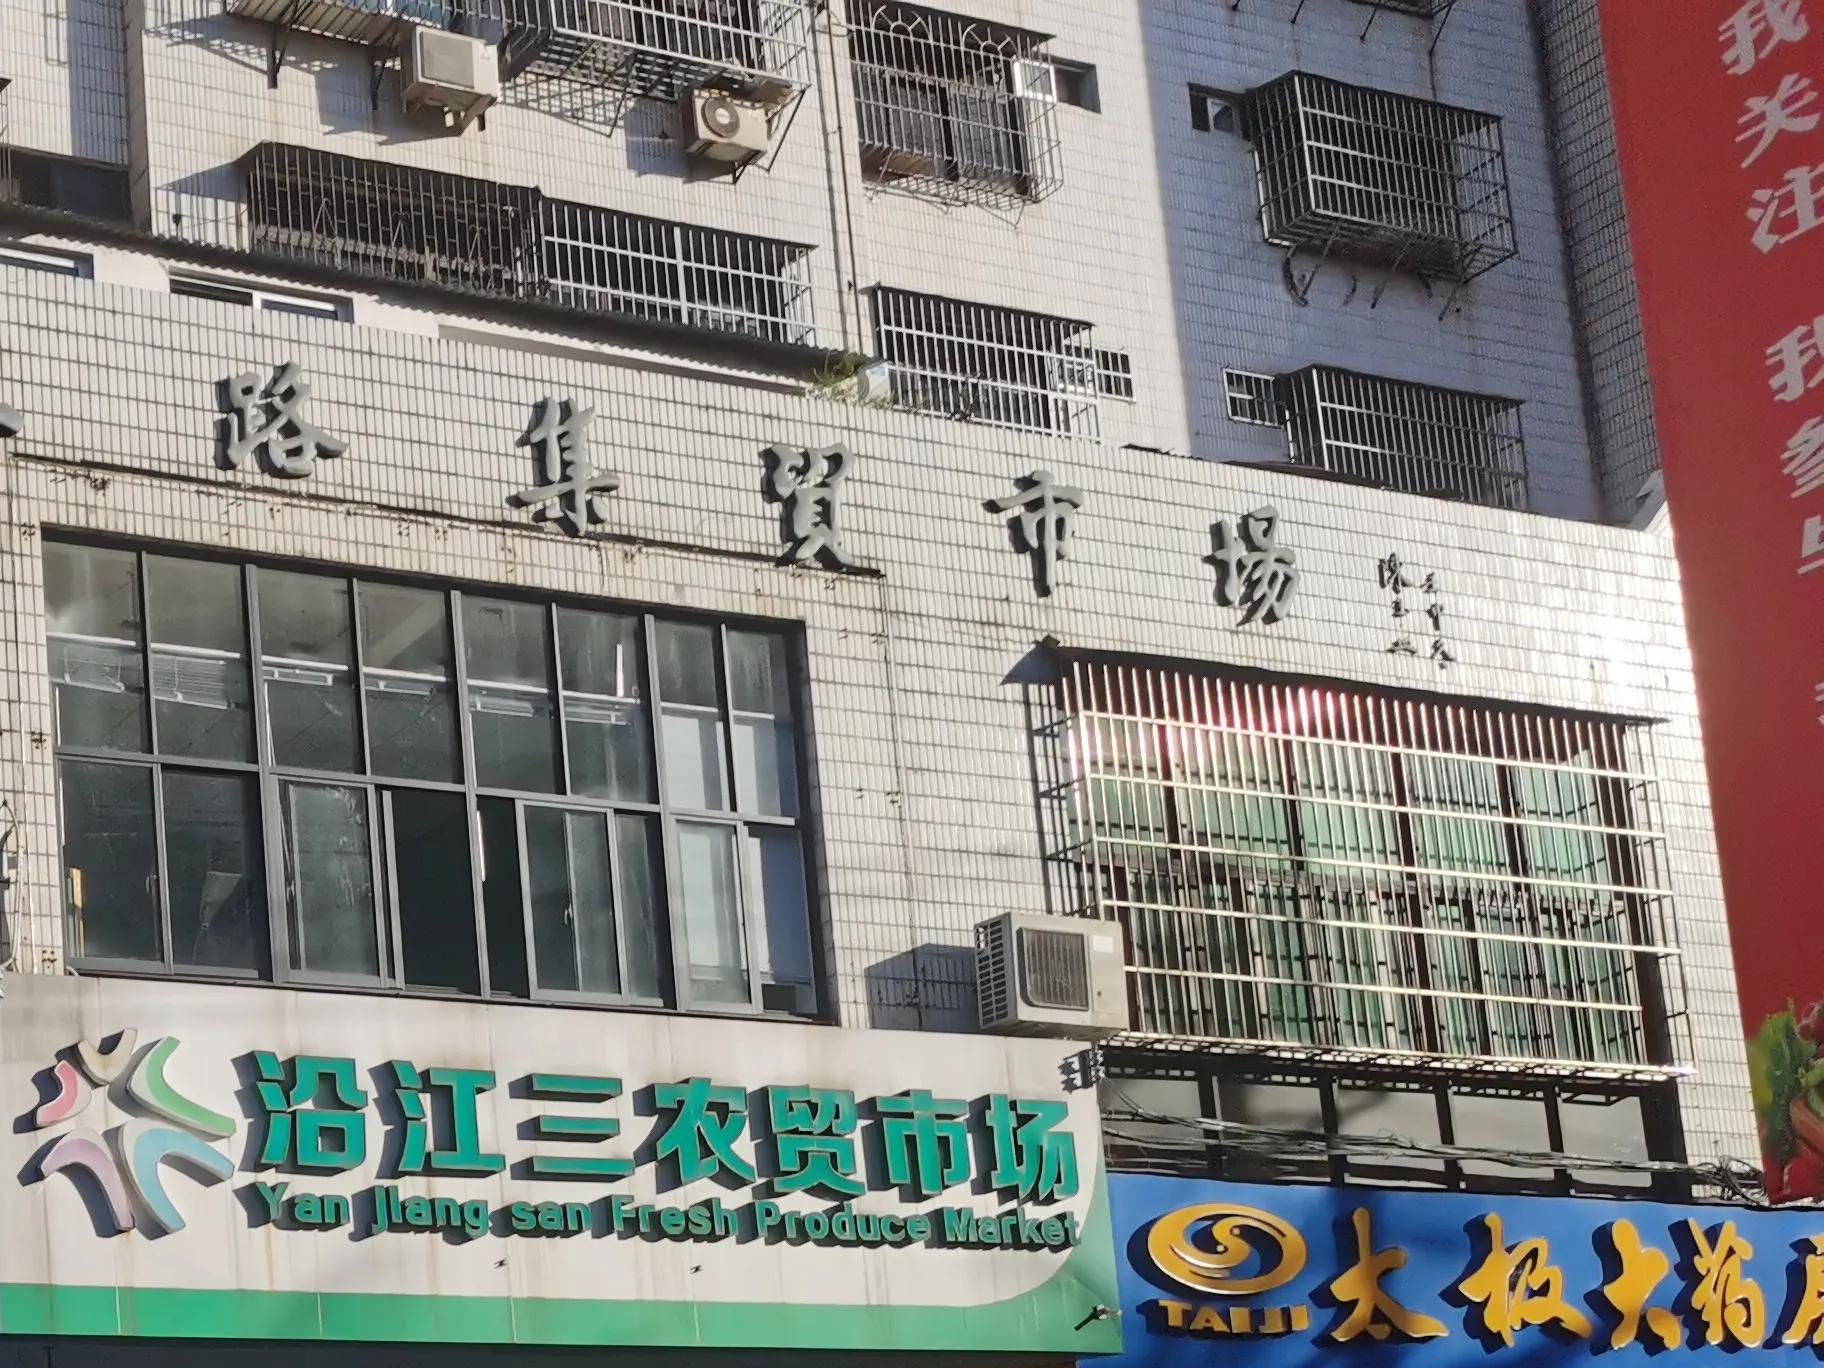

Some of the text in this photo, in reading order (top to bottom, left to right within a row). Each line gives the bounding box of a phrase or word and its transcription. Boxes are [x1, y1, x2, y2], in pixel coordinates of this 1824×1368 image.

[254, 1050, 1080, 1201] 沿江三农贸市场
[257, 1181, 350, 1226] Yan
[510, 1199, 592, 1232] san
[612, 1195, 738, 1236] Fresh
[756, 1199, 932, 1244] Produce
[944, 1206, 1081, 1248] Market
[1158, 1299, 1308, 1334] TAIJI
